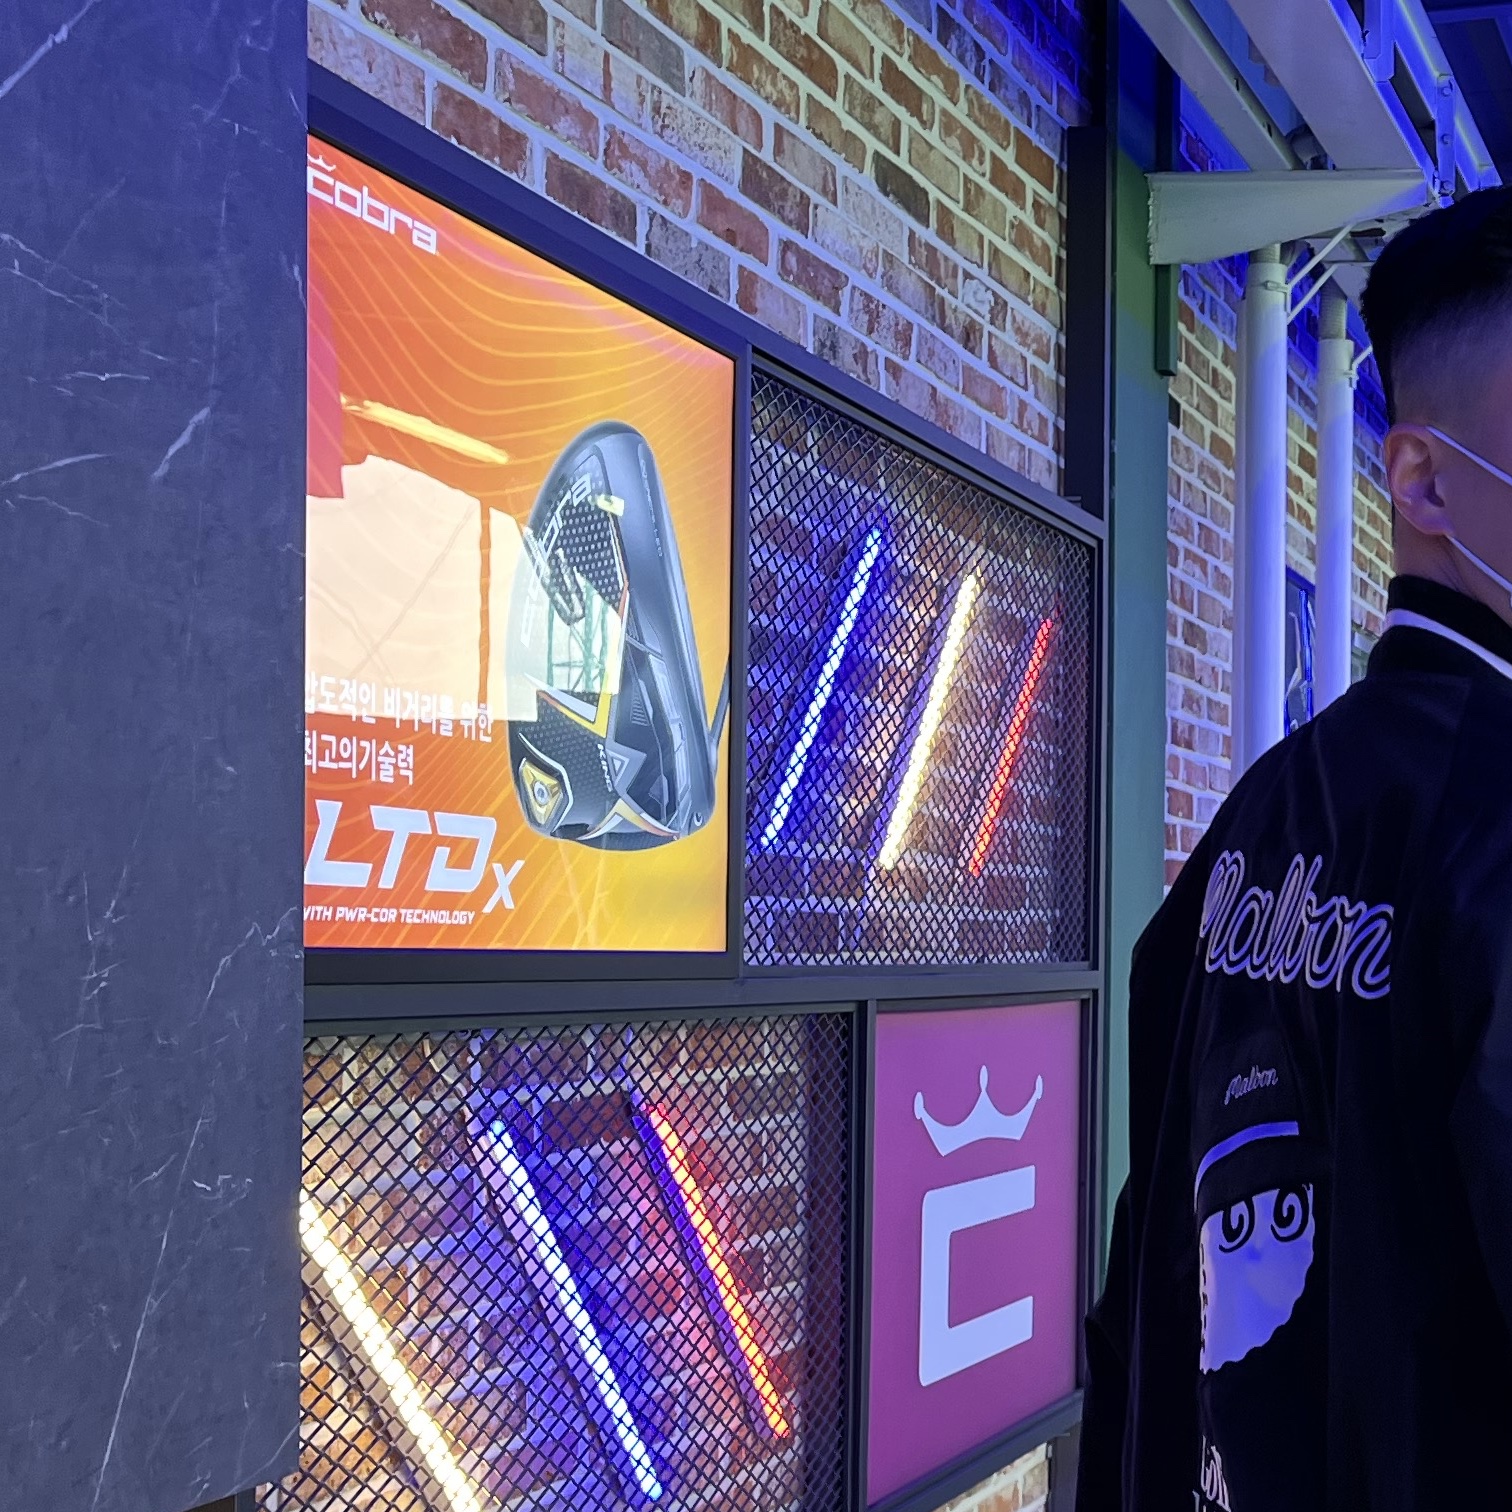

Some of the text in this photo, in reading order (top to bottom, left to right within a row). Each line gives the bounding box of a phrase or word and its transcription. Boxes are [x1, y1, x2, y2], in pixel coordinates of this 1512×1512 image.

[307, 164, 437, 255] cobra
[383, 687, 455, 738] 비거리를
[460, 700, 495, 743] 위한
[597, 743, 614, 794] KING
[335, 906, 396, 923] PWR-COR
[399, 909, 475, 925] TECHNOLOGY
[1224, 1065, 1279, 1106] Malbon
